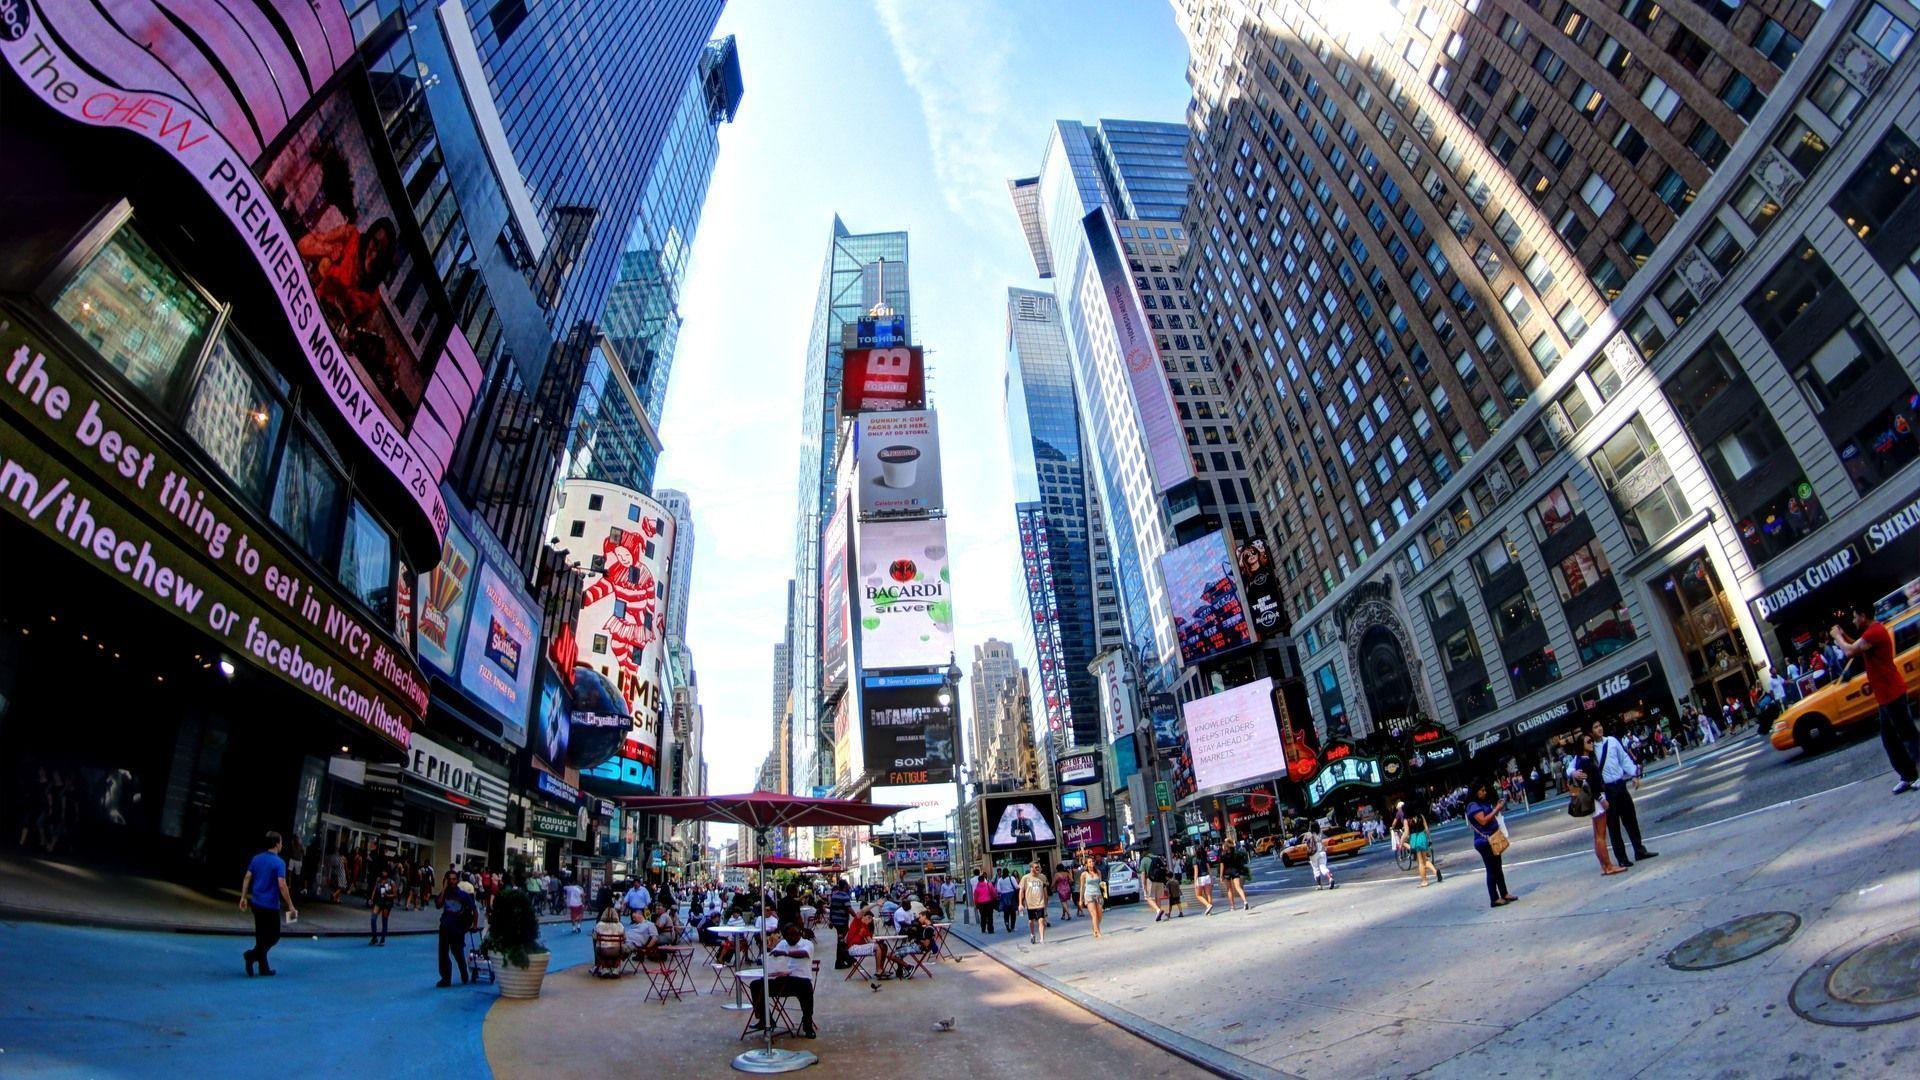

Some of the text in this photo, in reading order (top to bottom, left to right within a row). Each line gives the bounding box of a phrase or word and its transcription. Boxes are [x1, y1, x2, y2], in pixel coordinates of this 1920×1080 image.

[20, 32, 79, 104] The
[82, 92, 209, 151] CHEW
[209, 158, 313, 331] PREMIERES
[308, 323, 372, 426] MONDAY
[371, 421, 413, 475] SEPT
[411, 467, 427, 498] 26
[869, 307, 893, 316] 2011
[5, 345, 71, 421] the
[74, 400, 157, 490] best
[159, 471, 231, 560] thing
[236, 534, 260, 576] to
[265, 564, 301, 607] eat
[304, 585, 321, 627] in
[324, 605, 371, 661] NYC?
[470, 513, 526, 595] WRIGLEY'S
[866, 580, 942, 600] BACARDÍ
[1755, 579, 1809, 620] BUBBA
[1805, 549, 1851, 588] GUMP
[209, 602, 239, 637] or
[492, 633, 518, 663] Skittles
[1107, 660, 1124, 731] RICOH
[1195, 714, 1240, 733] KNOWLEDGE
[1196, 720, 1255, 744] HELPS TRADERS
[1465, 703, 1569, 760] Yankees CLUBHOUSE
[1199, 732, 1254, 754] STAY AHEAD OF
[889, 771, 929, 785] FATIGUE
[533, 815, 577, 827] STARBUCKS
[540, 822, 569, 833] COFFEE
